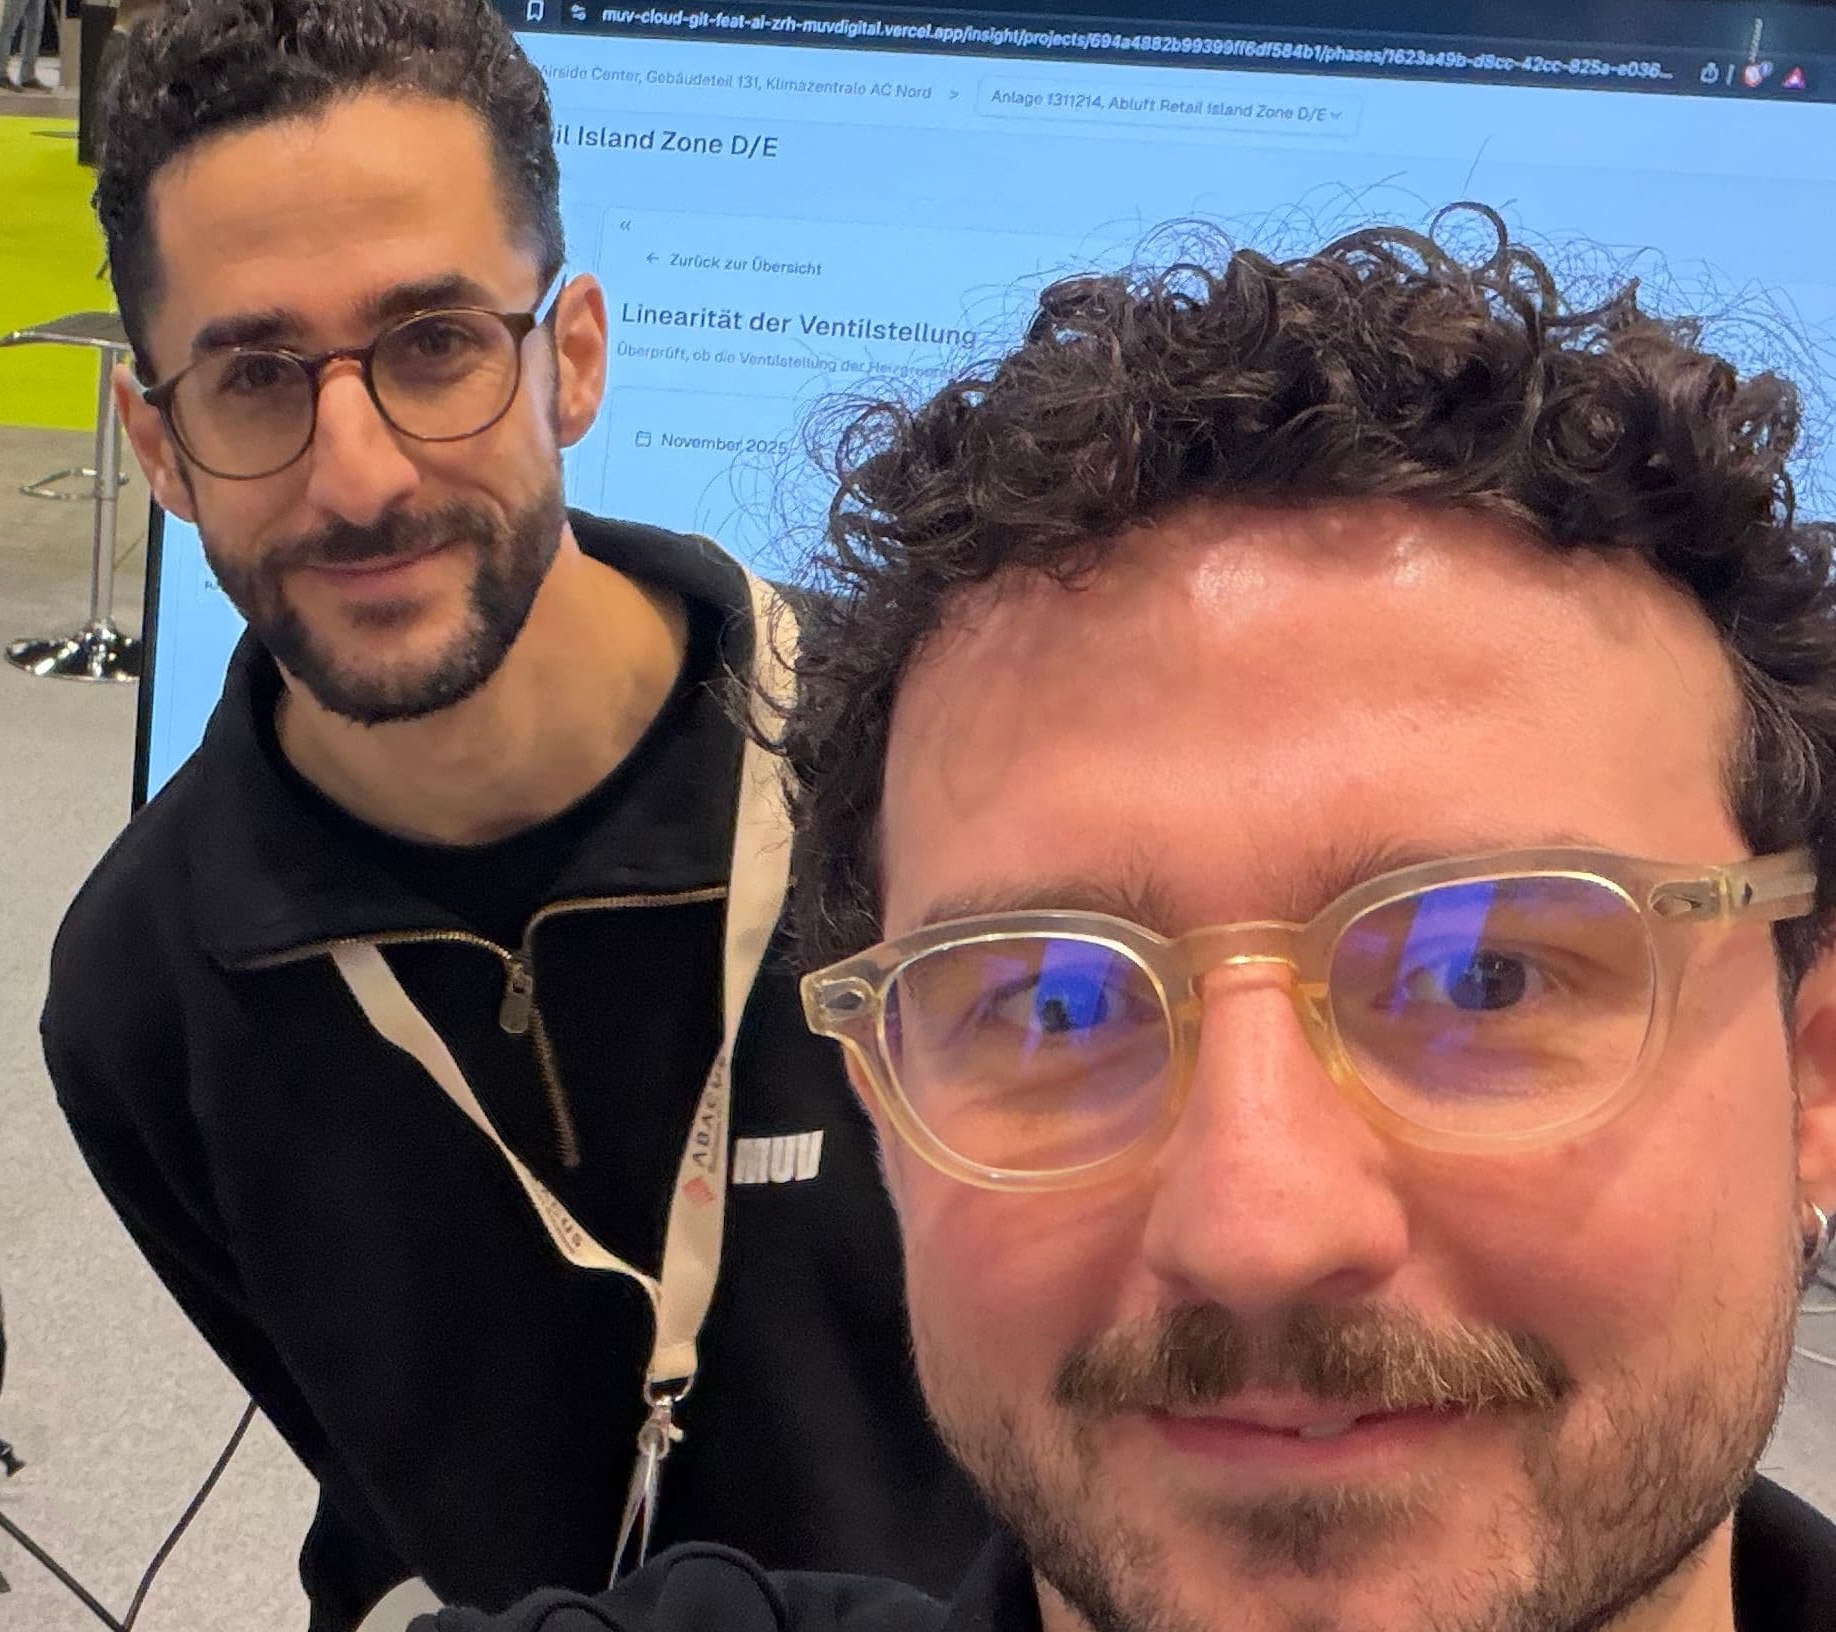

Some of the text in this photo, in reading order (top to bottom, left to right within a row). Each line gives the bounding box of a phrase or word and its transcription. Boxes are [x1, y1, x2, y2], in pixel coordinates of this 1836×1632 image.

[591, 67, 642, 84] Center,
[647, 69, 733, 89] Gebäudeteil
[766, 75, 866, 96] Klimazentrale
[895, 83, 932, 100] Nord
[991, 89, 1043, 108] Anlage
[1109, 95, 1154, 111] Abluft
[1161, 98, 1203, 115] Retail
[1207, 101, 1252, 118] Island
[1256, 104, 1293, 119] Zone
[1298, 106, 1328, 123] D/E
[578, 125, 654, 150] Island
[661, 131, 723, 154] Zone
[730, 134, 779, 159] D/E
[669, 253, 822, 277] Zurück zur Übersicht
[622, 303, 978, 349] Linearität der Ventilstellung
[692, 348, 711, 363] ob
[661, 433, 743, 453] November
